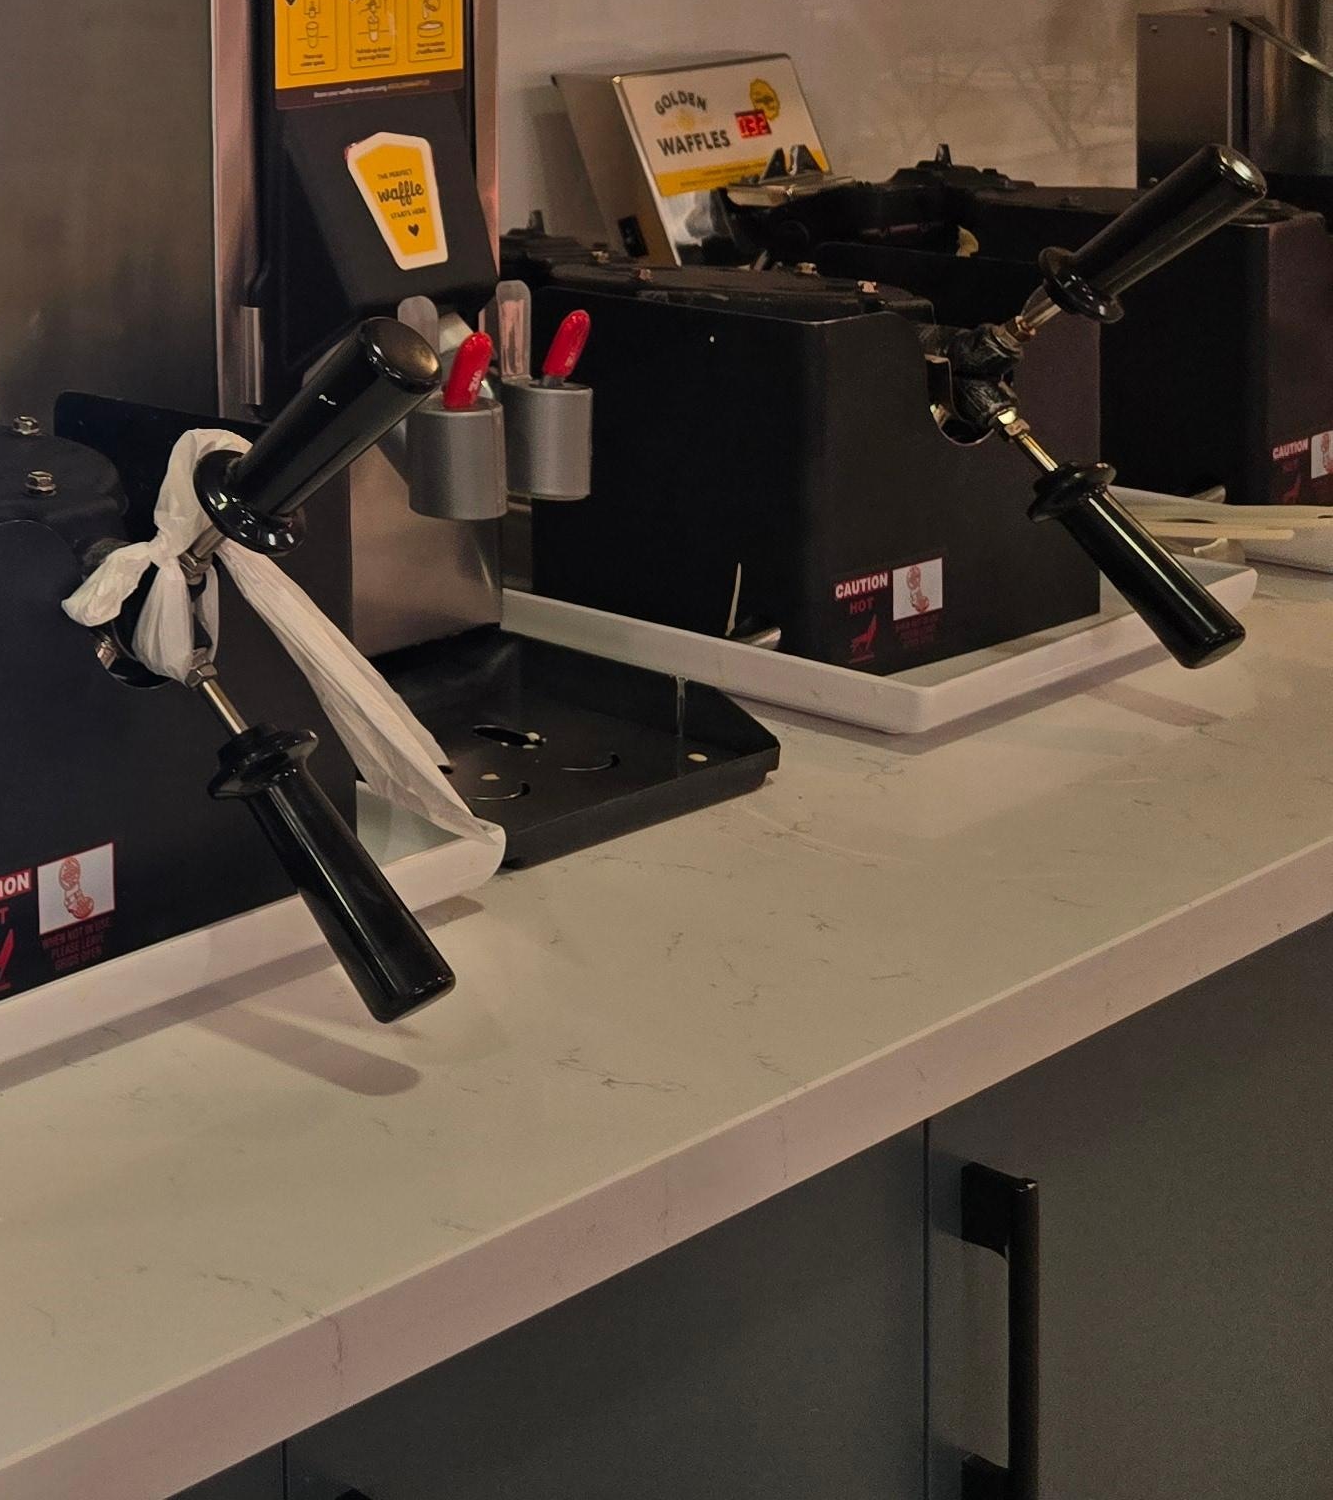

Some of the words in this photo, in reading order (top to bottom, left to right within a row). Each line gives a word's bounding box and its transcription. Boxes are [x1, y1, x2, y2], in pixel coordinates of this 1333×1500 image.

[655, 90, 707, 115] GOLDEN
[656, 129, 730, 156] WAFFLES
[377, 180, 424, 206] waffle
[1273, 438, 1309, 459] CAUTION
[835, 572, 889, 599] CAUTION
[849, 597, 875, 615] HOT
